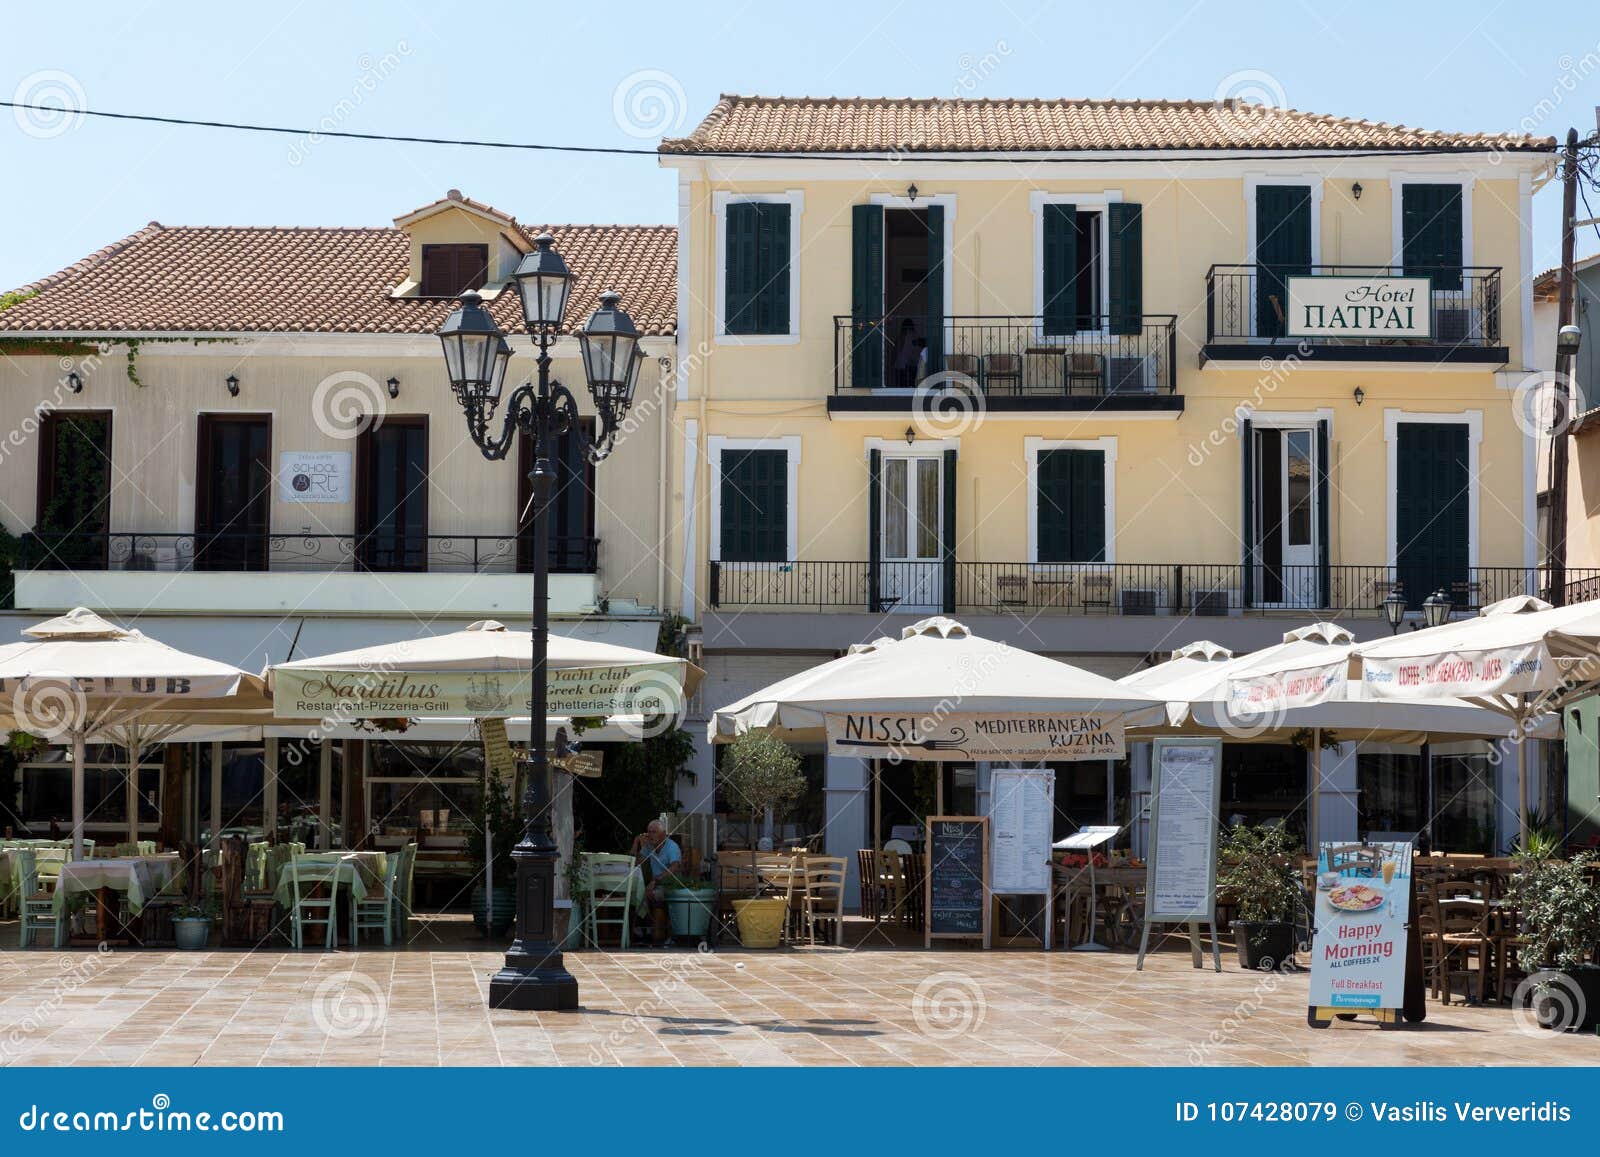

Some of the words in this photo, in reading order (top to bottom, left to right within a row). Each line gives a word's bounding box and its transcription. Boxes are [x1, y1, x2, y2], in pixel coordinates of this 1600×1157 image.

[1345, 284, 1415, 303] Hotel
[1303, 305, 1415, 329] ΠΑΤΡΑΙ
[555, 668, 595, 682] Yacht
[599, 667, 632, 680] club
[302, 673, 442, 699] Nautilus
[545, 684, 584, 695] Greek
[588, 683, 641, 695] Cuisine
[845, 714, 917, 742] NISSI
[975, 718, 1102, 734] MEDITERRANEAN
[1049, 732, 1116, 748] KUZINA
[1338, 924, 1382, 940] Happy
[1325, 940, 1393, 960] Morning
[1343, 957, 1372, 967] COFFEES
[1331, 979, 1345, 988] Full
[1346, 979, 1383, 990] Breakfast
